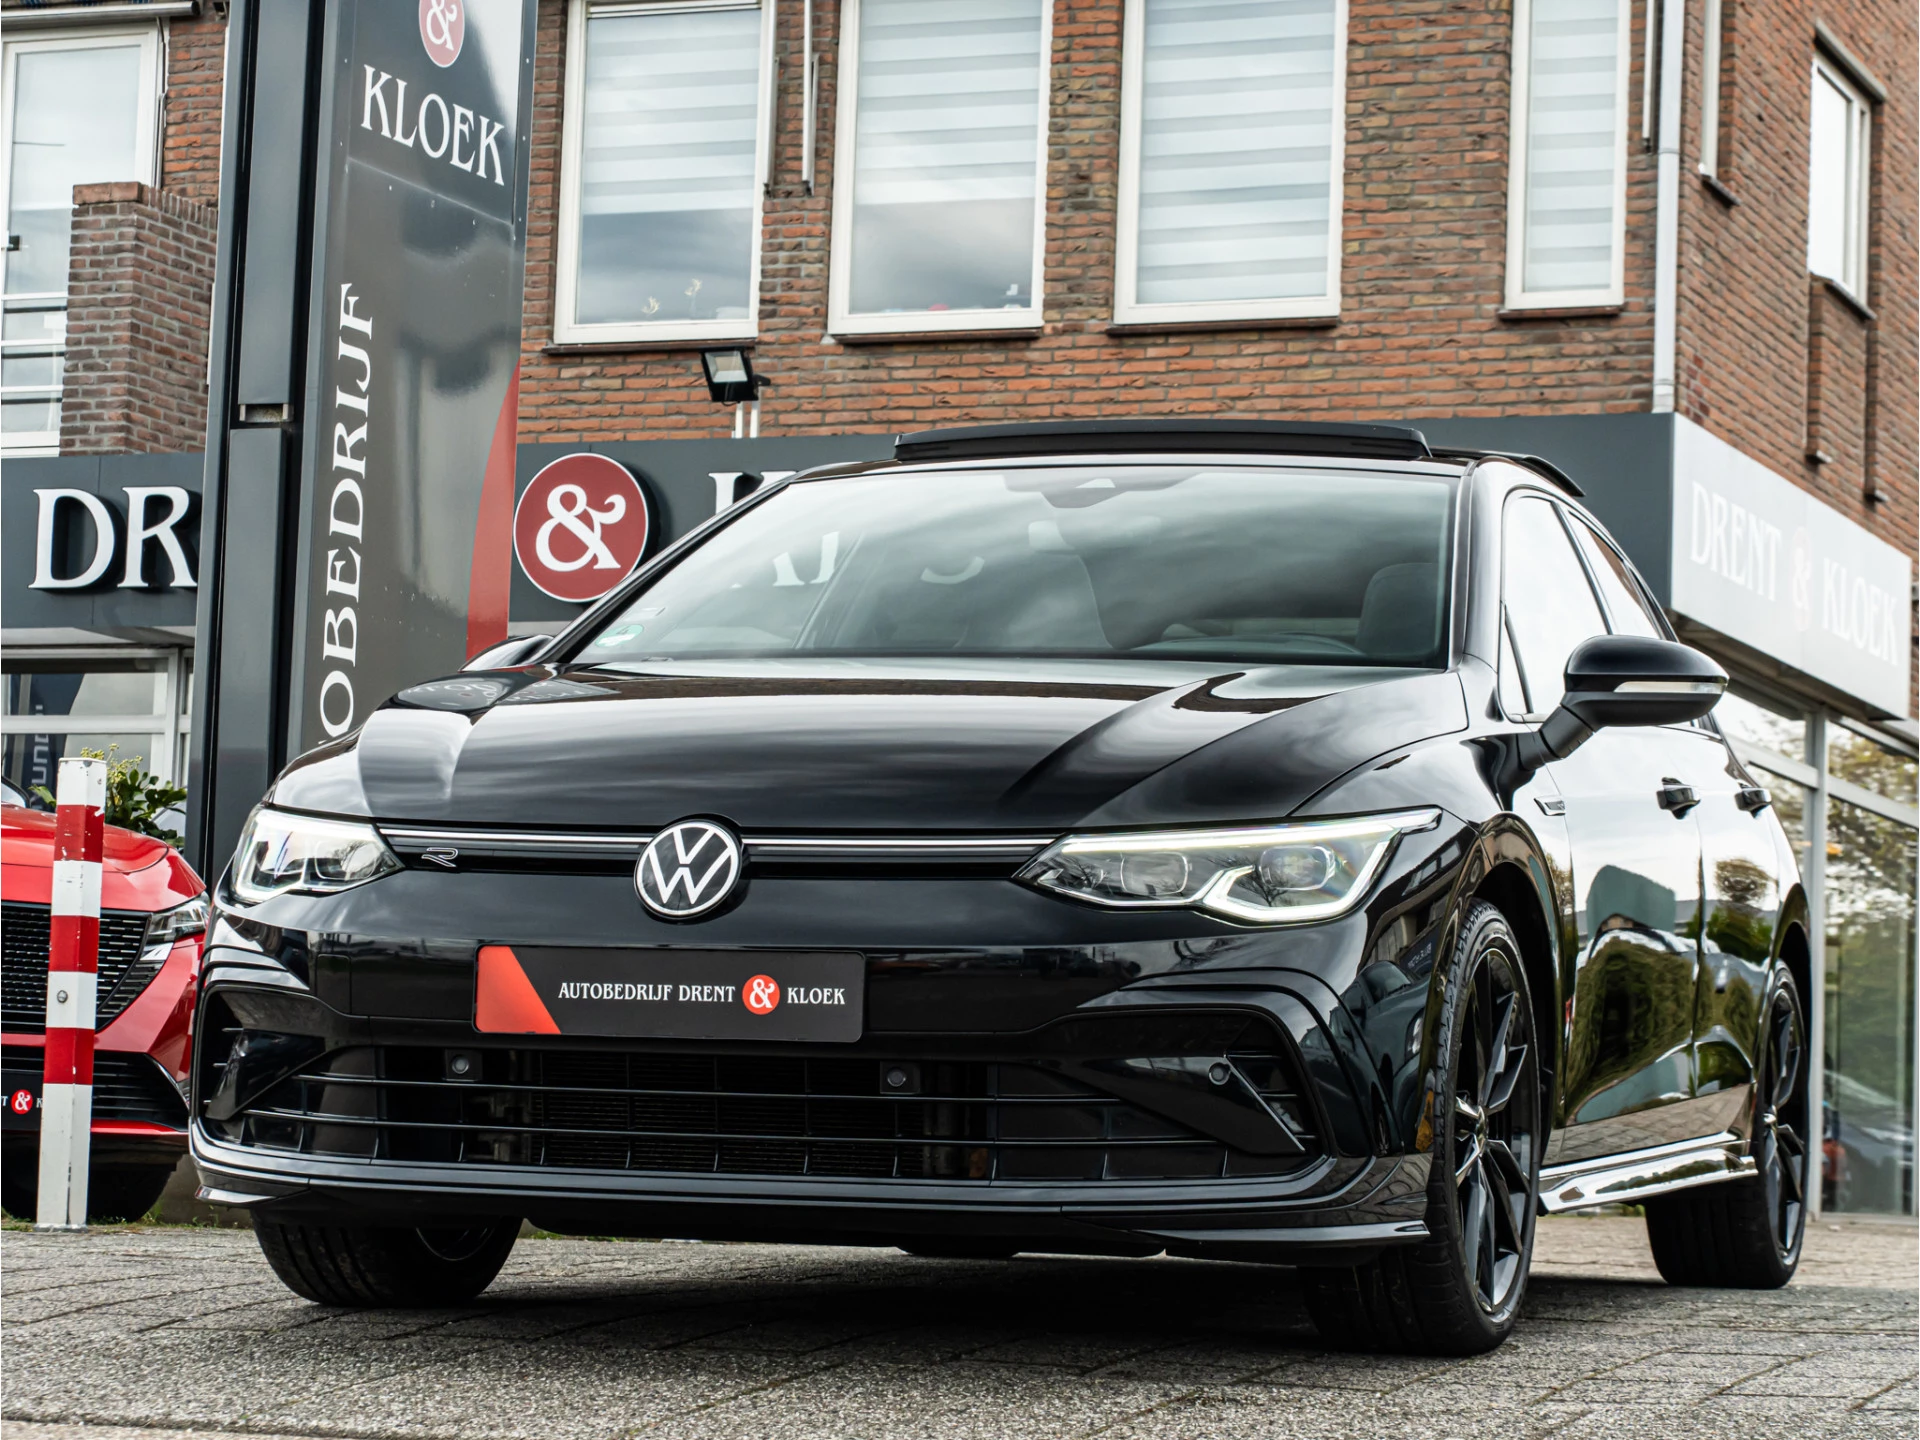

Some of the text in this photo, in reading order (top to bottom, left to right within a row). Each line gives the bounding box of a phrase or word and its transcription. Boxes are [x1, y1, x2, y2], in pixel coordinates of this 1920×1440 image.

[361, 64, 505, 186] KLOEK
[318, 282, 373, 744] OBEDRIJF
[536, 484, 626, 572] &
[1690, 480, 1782, 601] DRENT
[1822, 557, 1899, 667] KLOEK
[558, 978, 846, 1008] AUTOBEDRIJF DRENT & KLOEK
